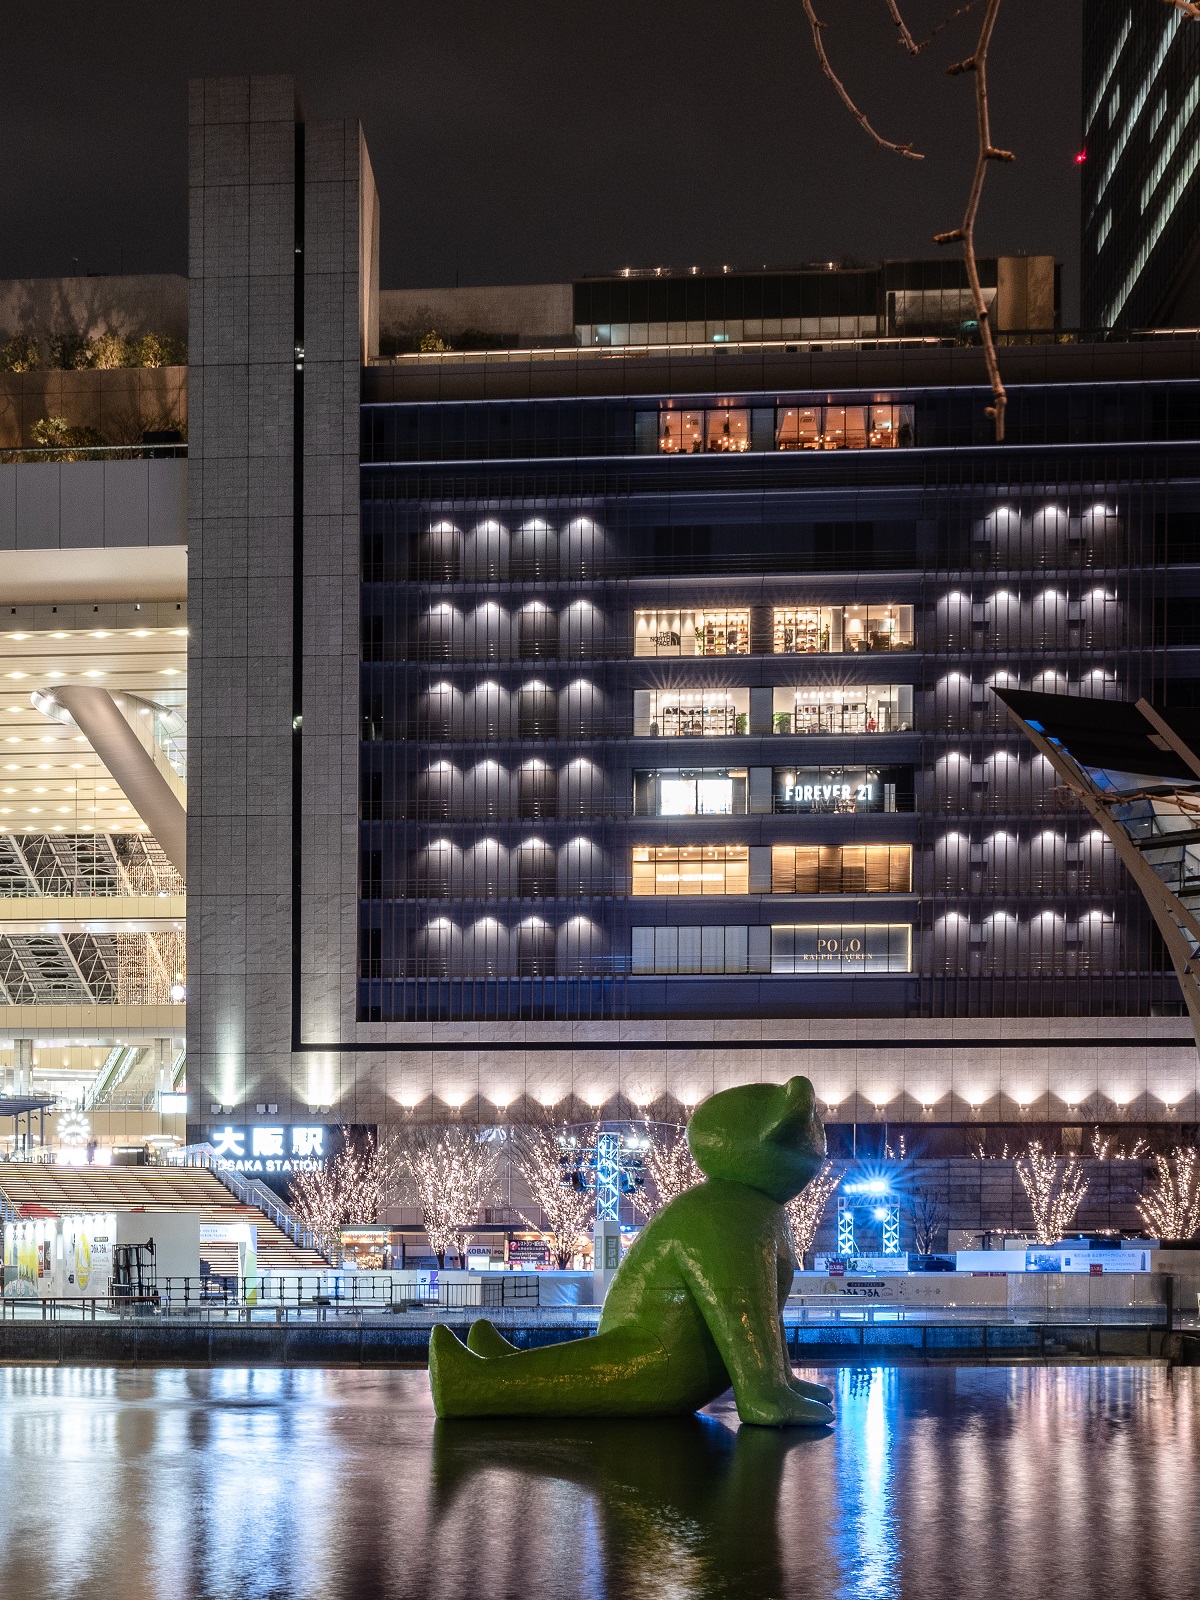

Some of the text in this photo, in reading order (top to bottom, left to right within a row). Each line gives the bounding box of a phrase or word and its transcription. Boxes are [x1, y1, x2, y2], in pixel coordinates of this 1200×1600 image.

[785, 784, 873, 801] FOREVER 21
[817, 938, 861, 953] POLO
[213, 1126, 323, 1156] 大阪駅
[217, 1159, 322, 1172] OSAKA STATION
